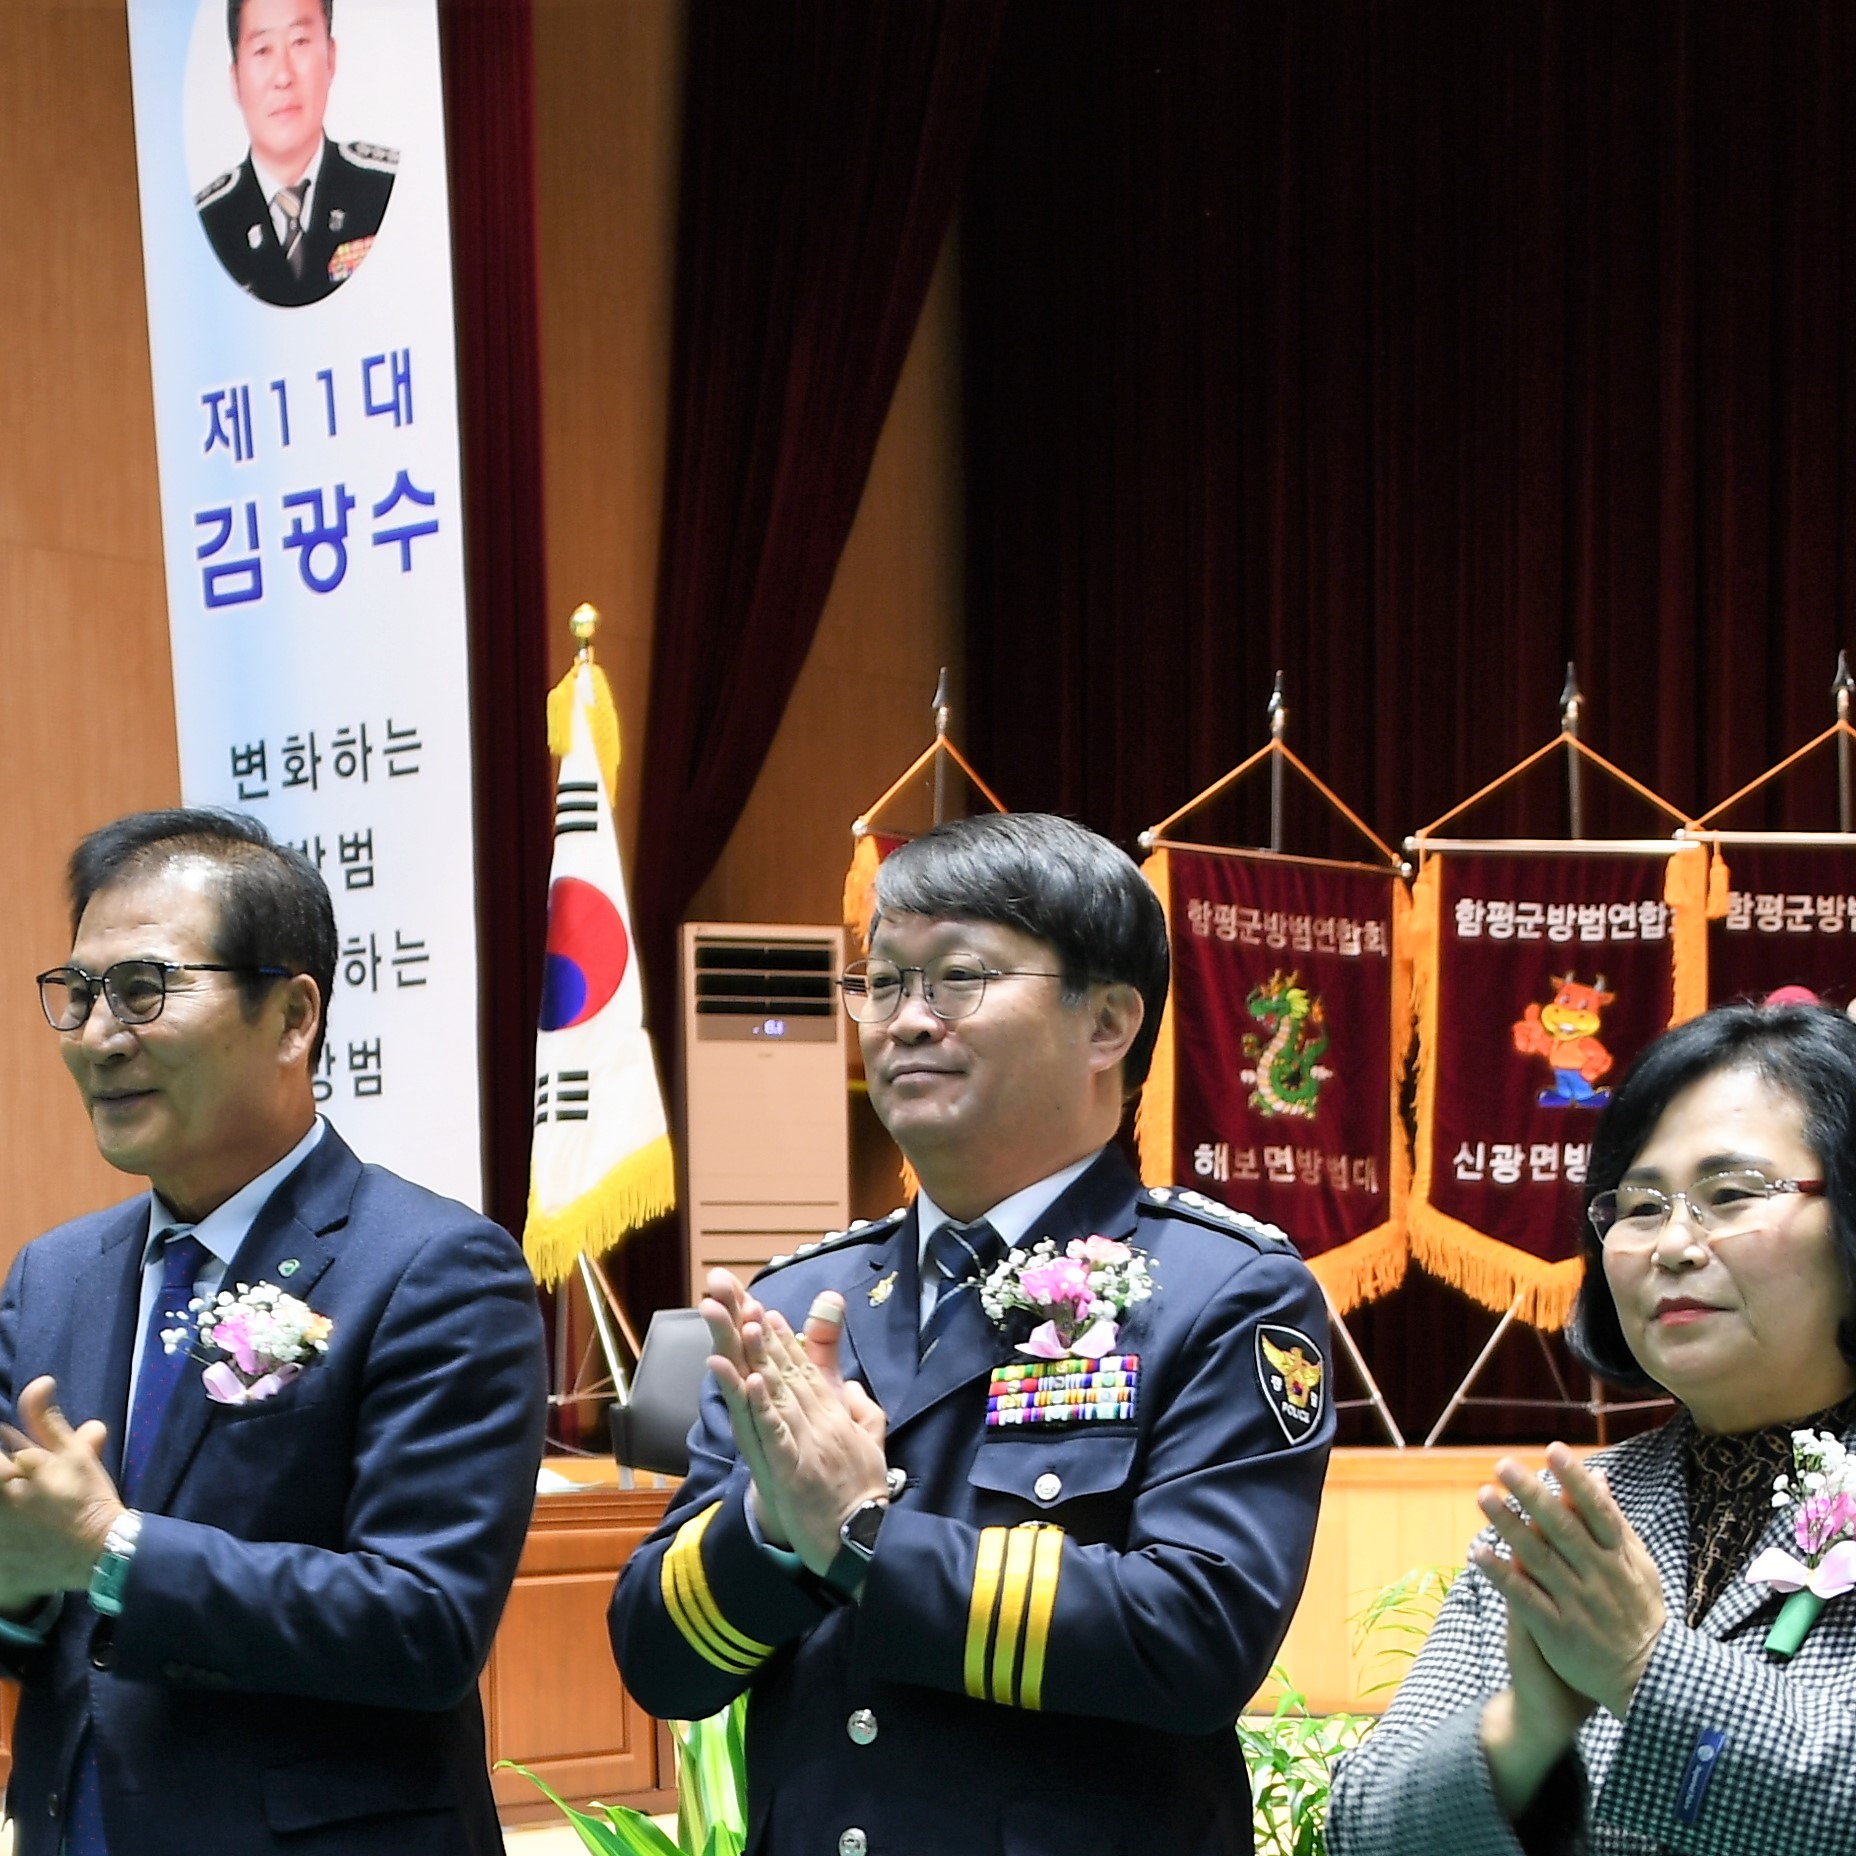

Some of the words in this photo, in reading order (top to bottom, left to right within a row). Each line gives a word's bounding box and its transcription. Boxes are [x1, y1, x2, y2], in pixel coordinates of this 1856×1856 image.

[200, 346, 415, 463] 제11대
[194, 468, 440, 609] 김광수
[230, 718, 423, 802] 변화하는
[1187, 898, 1388, 957] 함평군방범연합회
[1455, 898, 1677, 942] 함평군방범연합
[1194, 1142, 1380, 1194] 해보면방범대
[1281, 1401, 1311, 1424] POLICE
